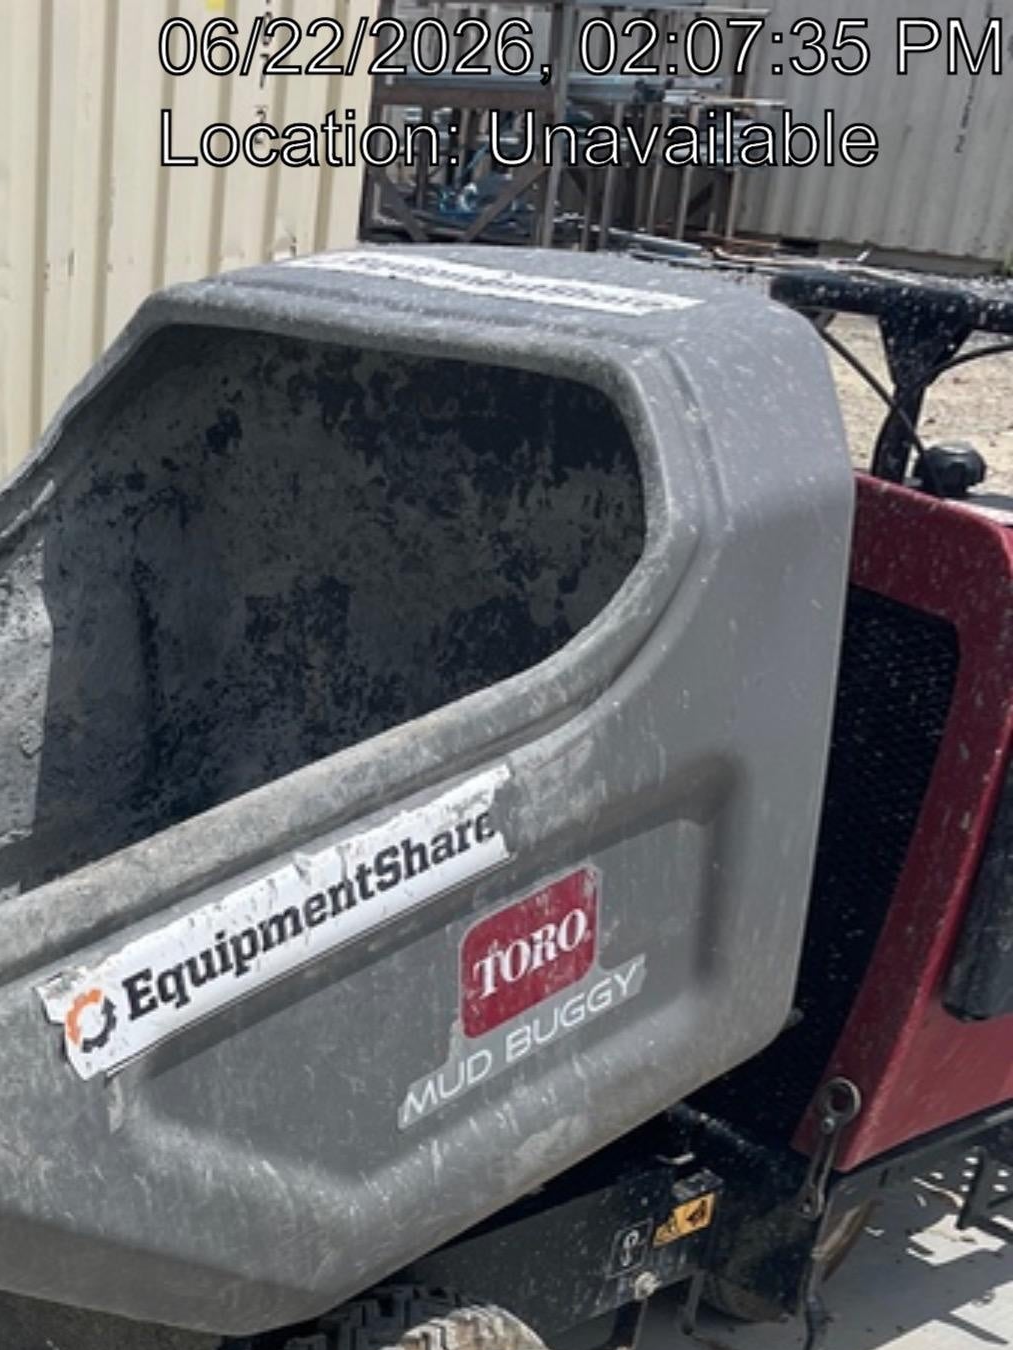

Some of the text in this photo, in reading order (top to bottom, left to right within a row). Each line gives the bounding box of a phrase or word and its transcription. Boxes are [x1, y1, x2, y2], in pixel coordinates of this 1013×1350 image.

[120, 809, 496, 1021] EquipmentShare
[472, 908, 588, 1000] TORO
[402, 962, 637, 1123] MUD BUGGY
